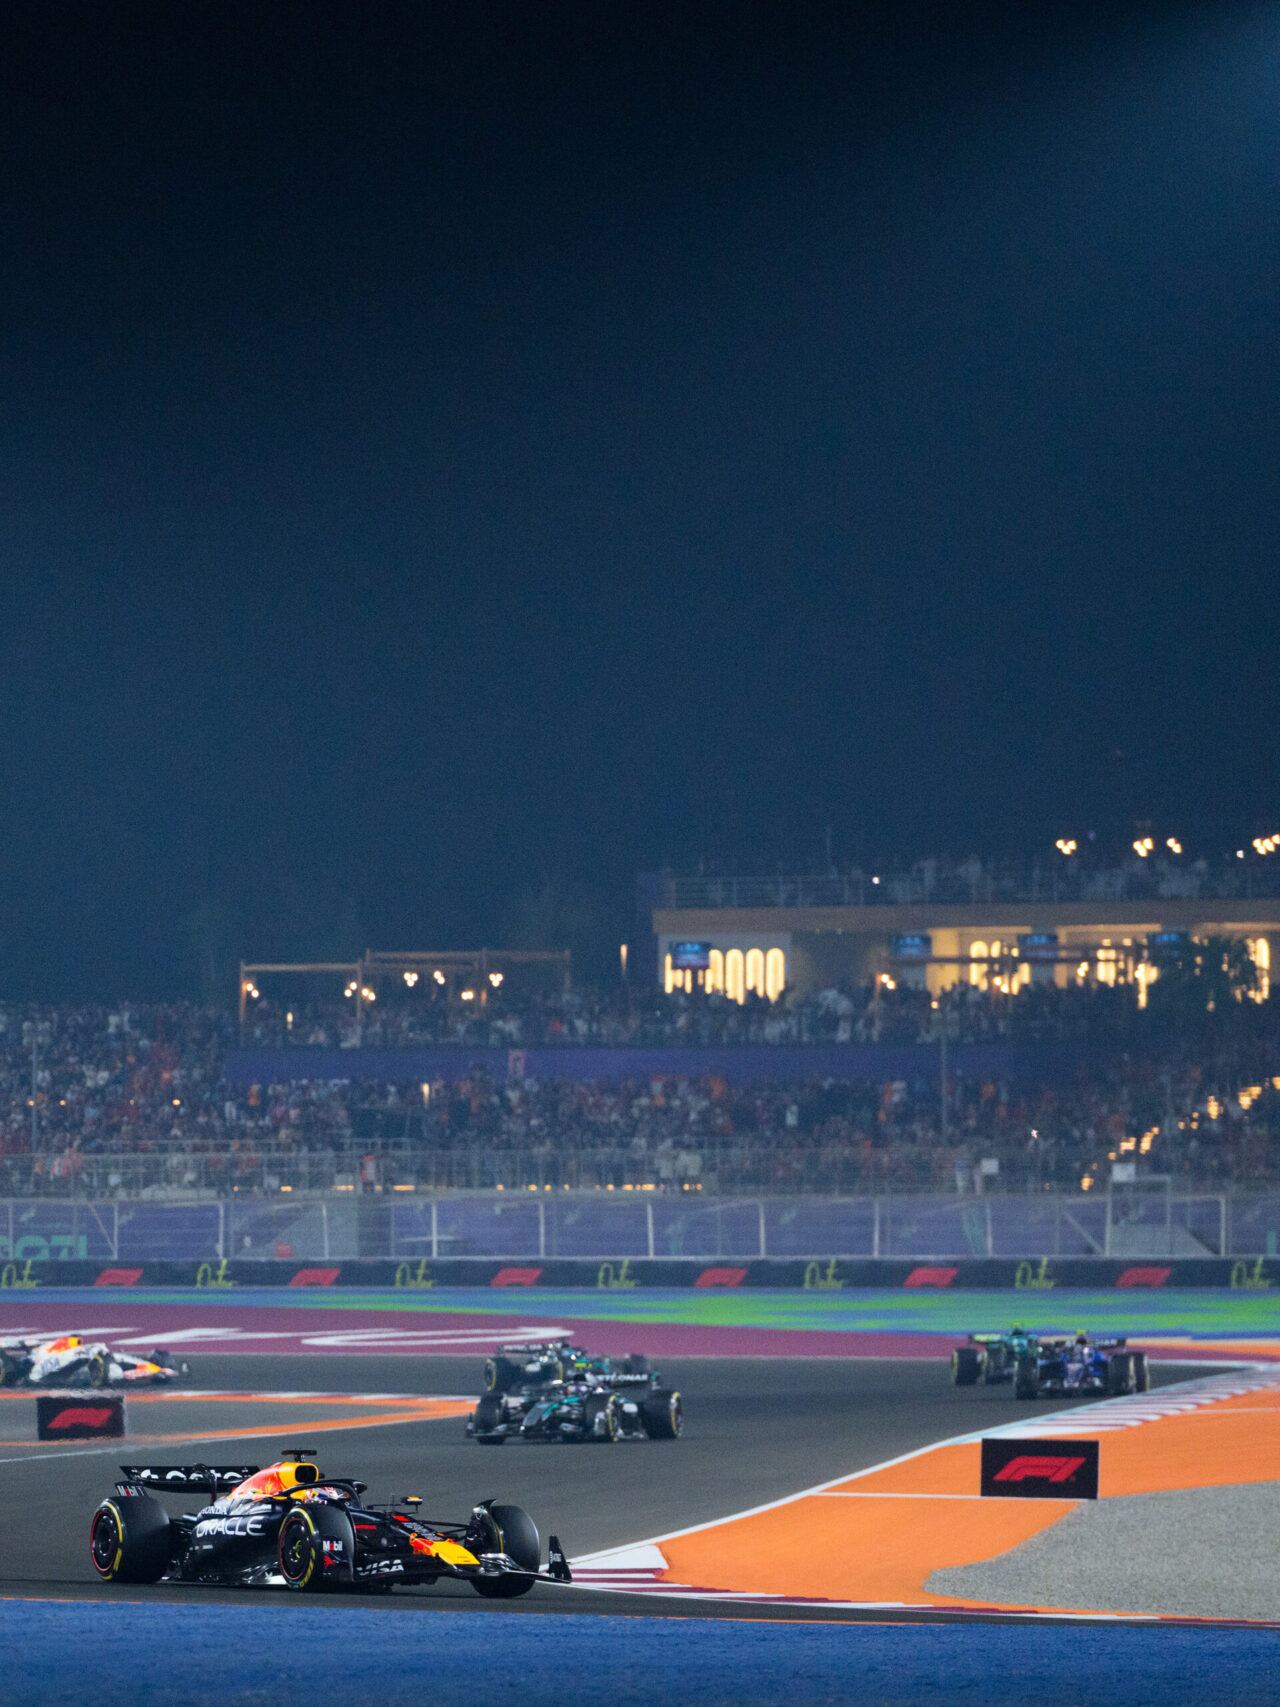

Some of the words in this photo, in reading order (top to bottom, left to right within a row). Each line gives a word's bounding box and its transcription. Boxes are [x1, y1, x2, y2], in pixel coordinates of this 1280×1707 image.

[993, 1455, 1087, 1483] F1
[196, 1515, 266, 1538] ORACLE
[322, 1540, 343, 1551] Mobil
[356, 1559, 404, 1576] VISA
